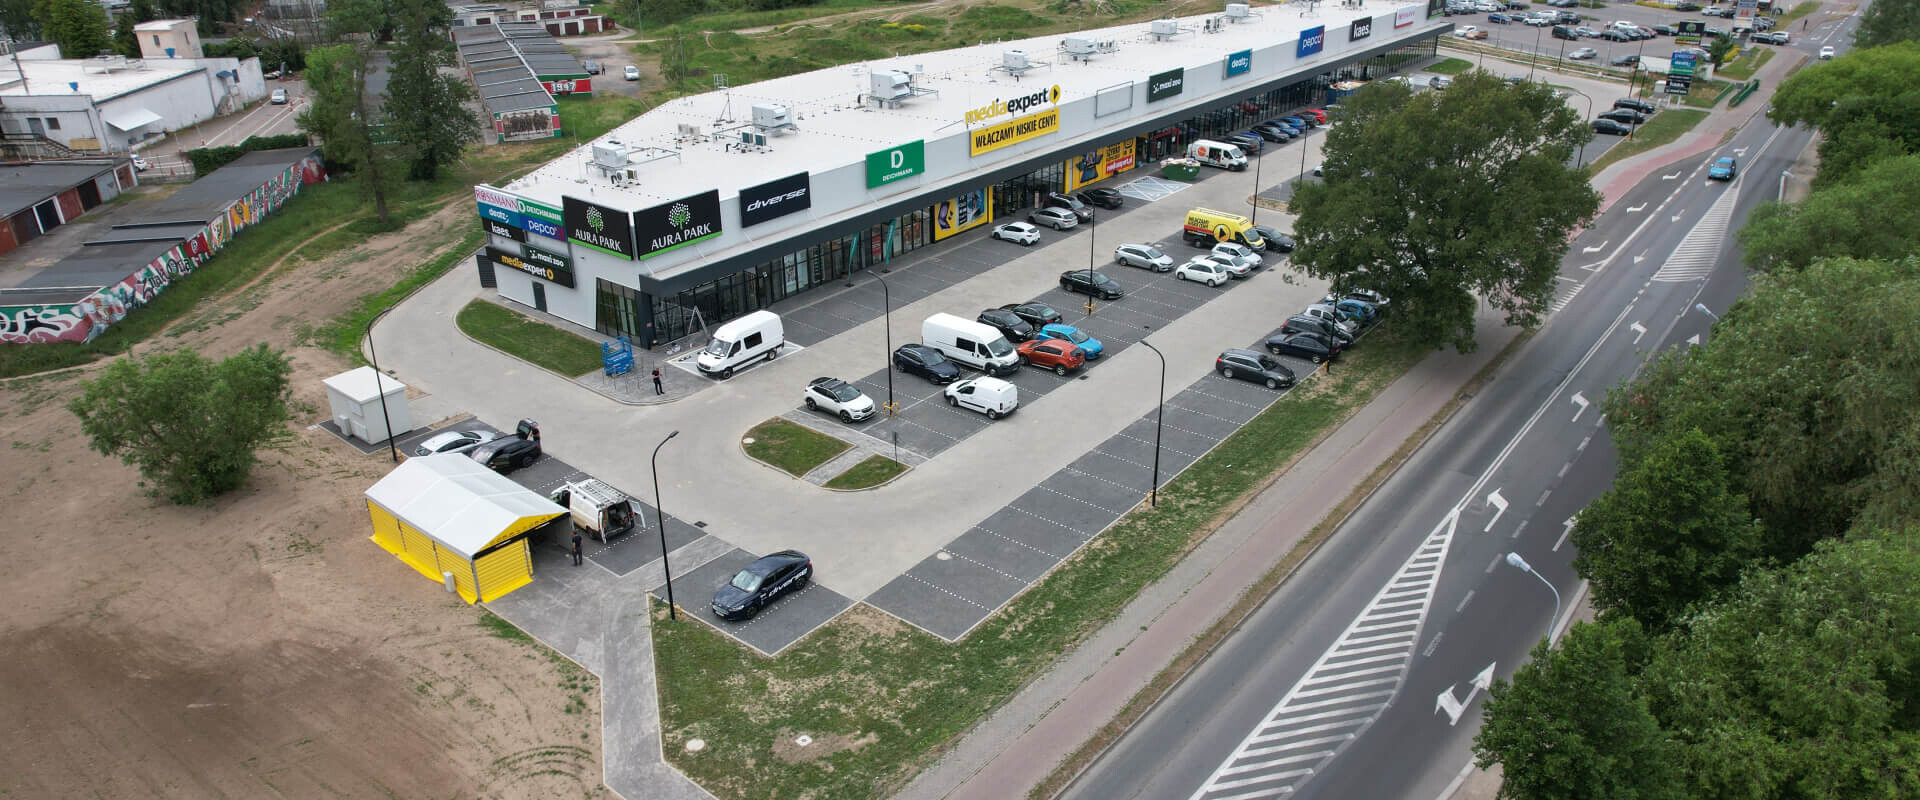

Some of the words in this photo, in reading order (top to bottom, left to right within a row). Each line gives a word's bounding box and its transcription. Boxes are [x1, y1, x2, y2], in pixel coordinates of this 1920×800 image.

[1302, 33, 1322, 50] pepco
[965, 88, 1049, 126] mediaexpert
[975, 126, 1015, 149] WŁĄCZAMY
[1016, 119, 1037, 137] NISKIE
[1038, 114, 1057, 130] CENY!
[882, 167, 913, 182] DEICHMANN
[474, 189, 519, 212] ROSSMANN
[746, 187, 807, 213] diverse
[526, 205, 562, 221] DEICHMANN
[527, 219, 558, 236] pepco
[651, 232, 682, 251] AURA
[683, 222, 712, 240] PARK
[575, 229, 598, 244] AURA
[599, 235, 622, 252] PARK
[501, 255, 547, 277] mediaexpert
[552, 258, 565, 267] zoo
[768, 568, 808, 597] diverse
